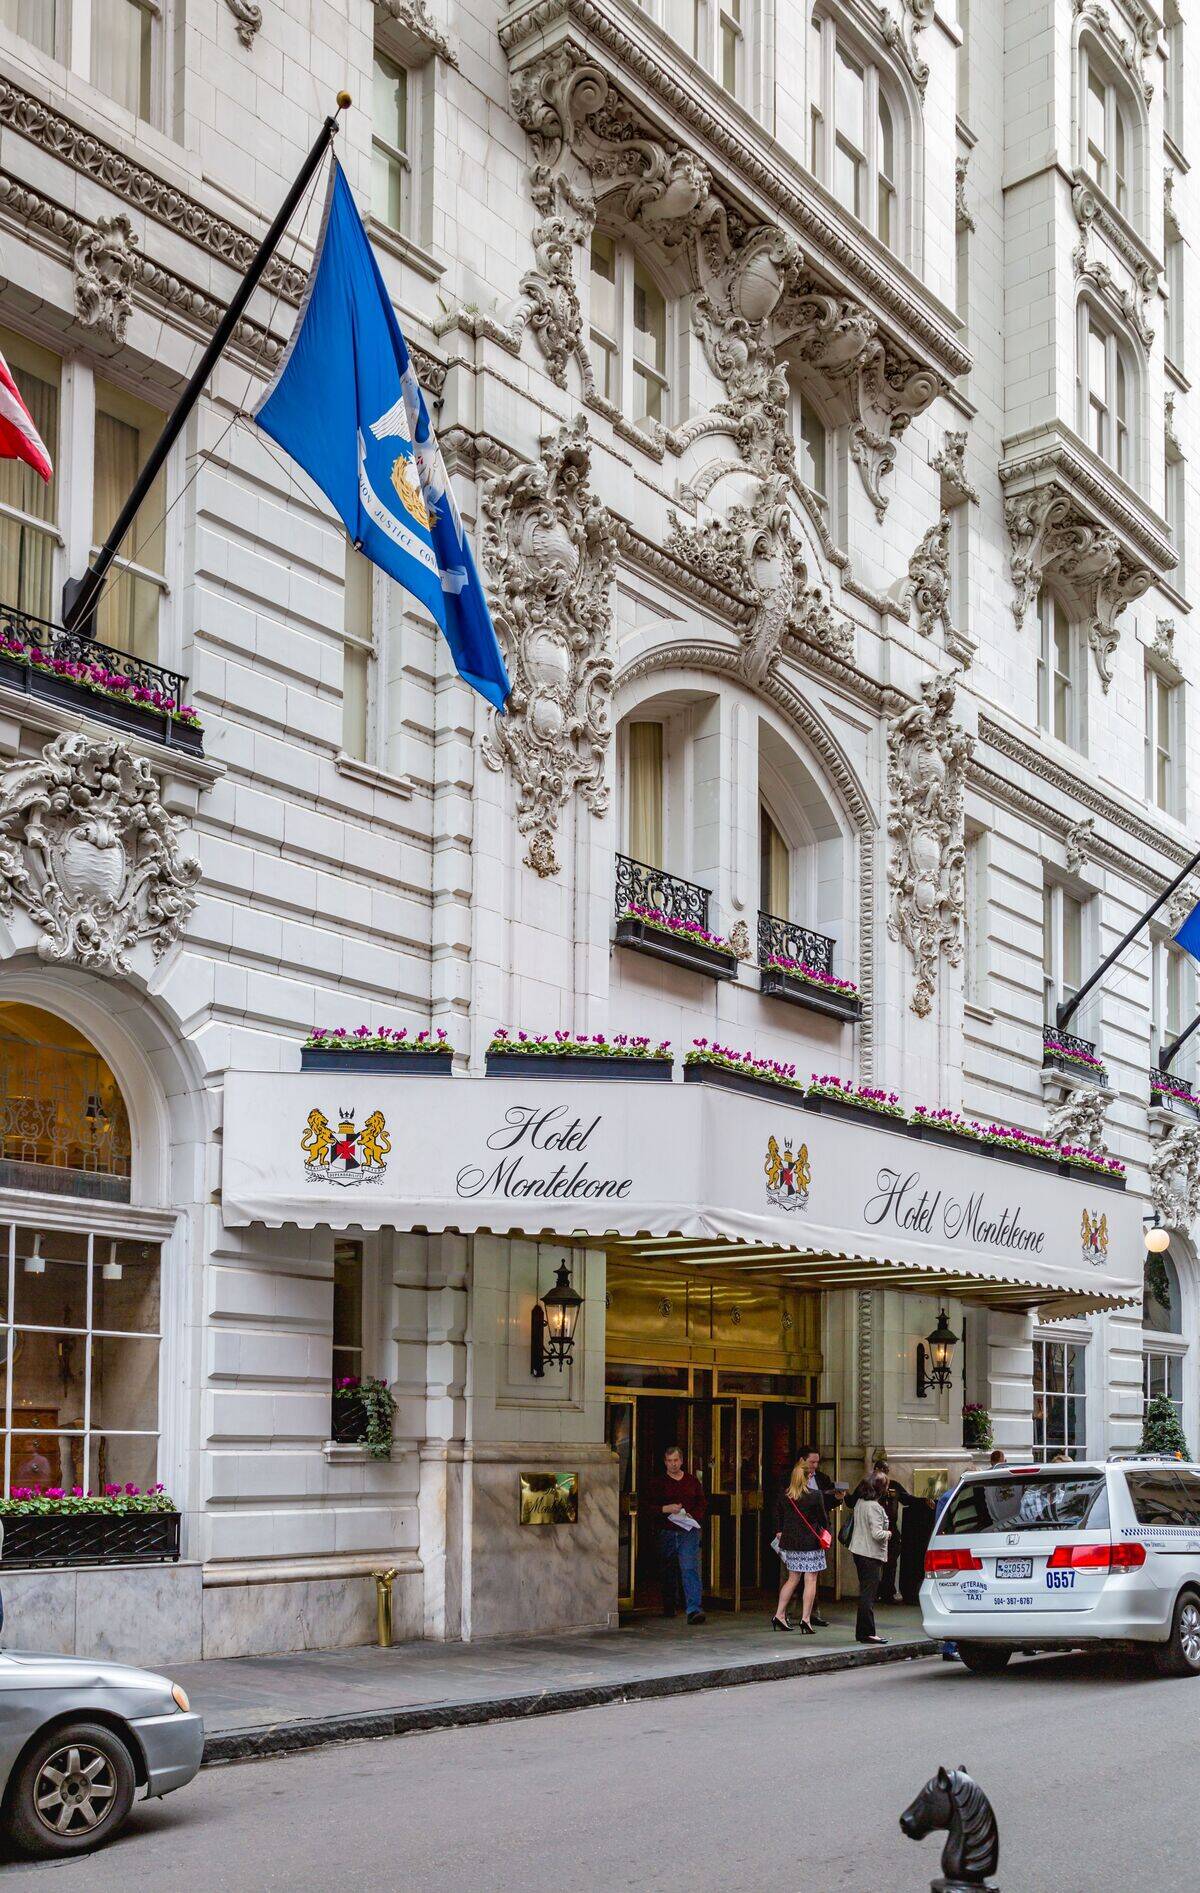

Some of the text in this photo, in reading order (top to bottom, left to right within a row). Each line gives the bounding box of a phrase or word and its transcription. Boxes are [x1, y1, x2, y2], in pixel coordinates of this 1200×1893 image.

[374, 509, 413, 547] JUSTICE
[486, 1104, 602, 1151] Hotel
[456, 1155, 633, 1199] Monteleone
[863, 1168, 1045, 1253] Hotel Monteleone
[1012, 1563, 1030, 1573] 0557
[1046, 1571, 1076, 1589] 0557
[960, 1580, 988, 1591] VETERANS
[966, 1593, 982, 1601] TAXI
